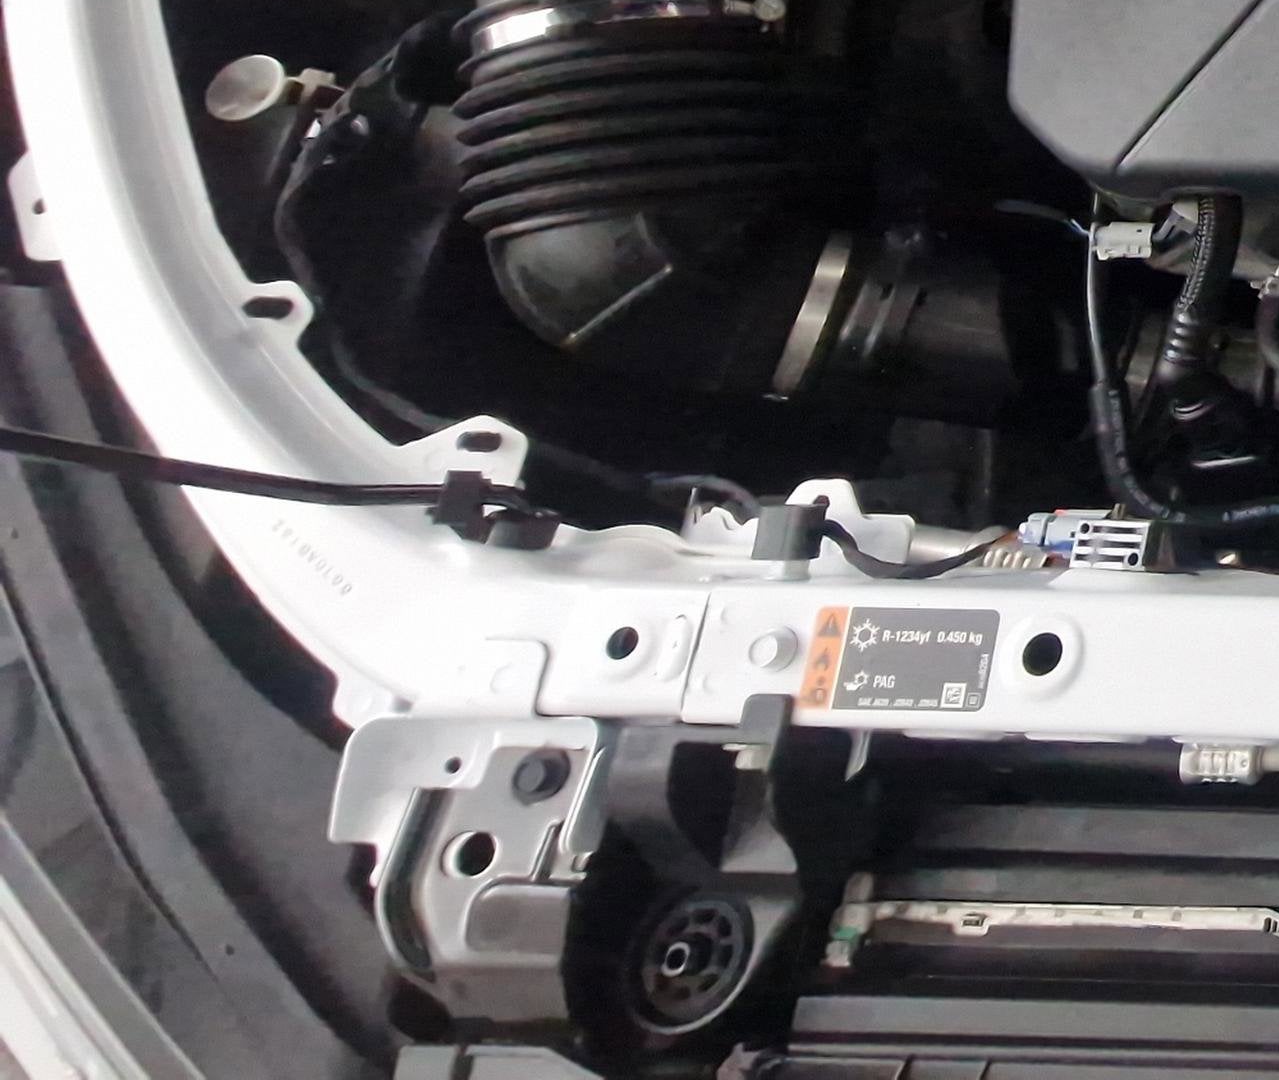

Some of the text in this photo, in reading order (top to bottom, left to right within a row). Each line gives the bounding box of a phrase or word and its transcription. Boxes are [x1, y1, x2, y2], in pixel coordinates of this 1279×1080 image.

[882, 629, 984, 646] R-1234yf 0.450 kg
[873, 674, 896, 689] PAG
